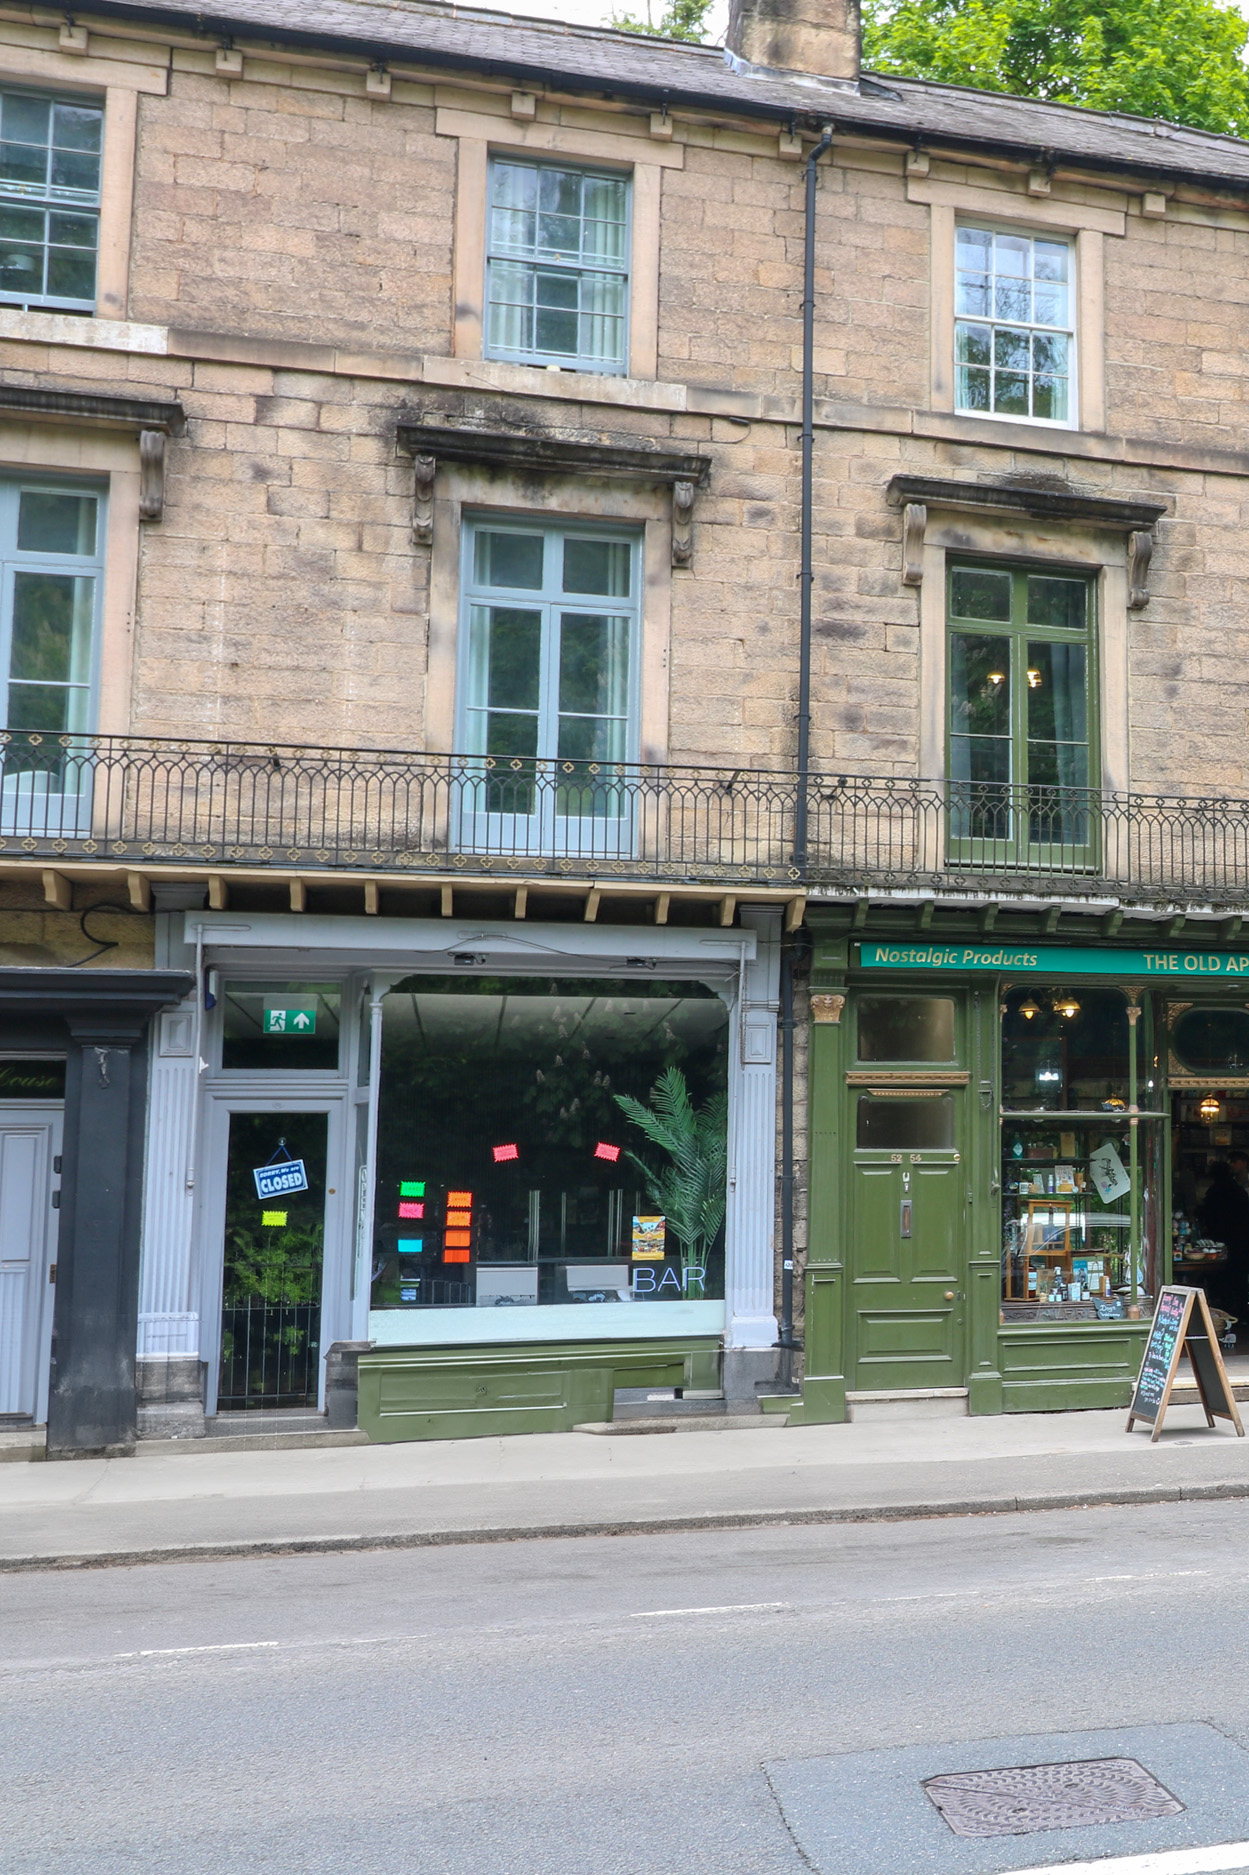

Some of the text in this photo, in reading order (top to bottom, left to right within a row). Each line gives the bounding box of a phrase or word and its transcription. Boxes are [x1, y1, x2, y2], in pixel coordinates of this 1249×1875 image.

[875, 948, 1038, 966] Nostalgic Products
[1143, 954, 1179, 970] THE
[1184, 955, 1221, 971] OLD
[891, 1154, 922, 1162] 52 54
[261, 1172, 302, 1193] CLOSED
[633, 1266, 706, 1293] BAR
